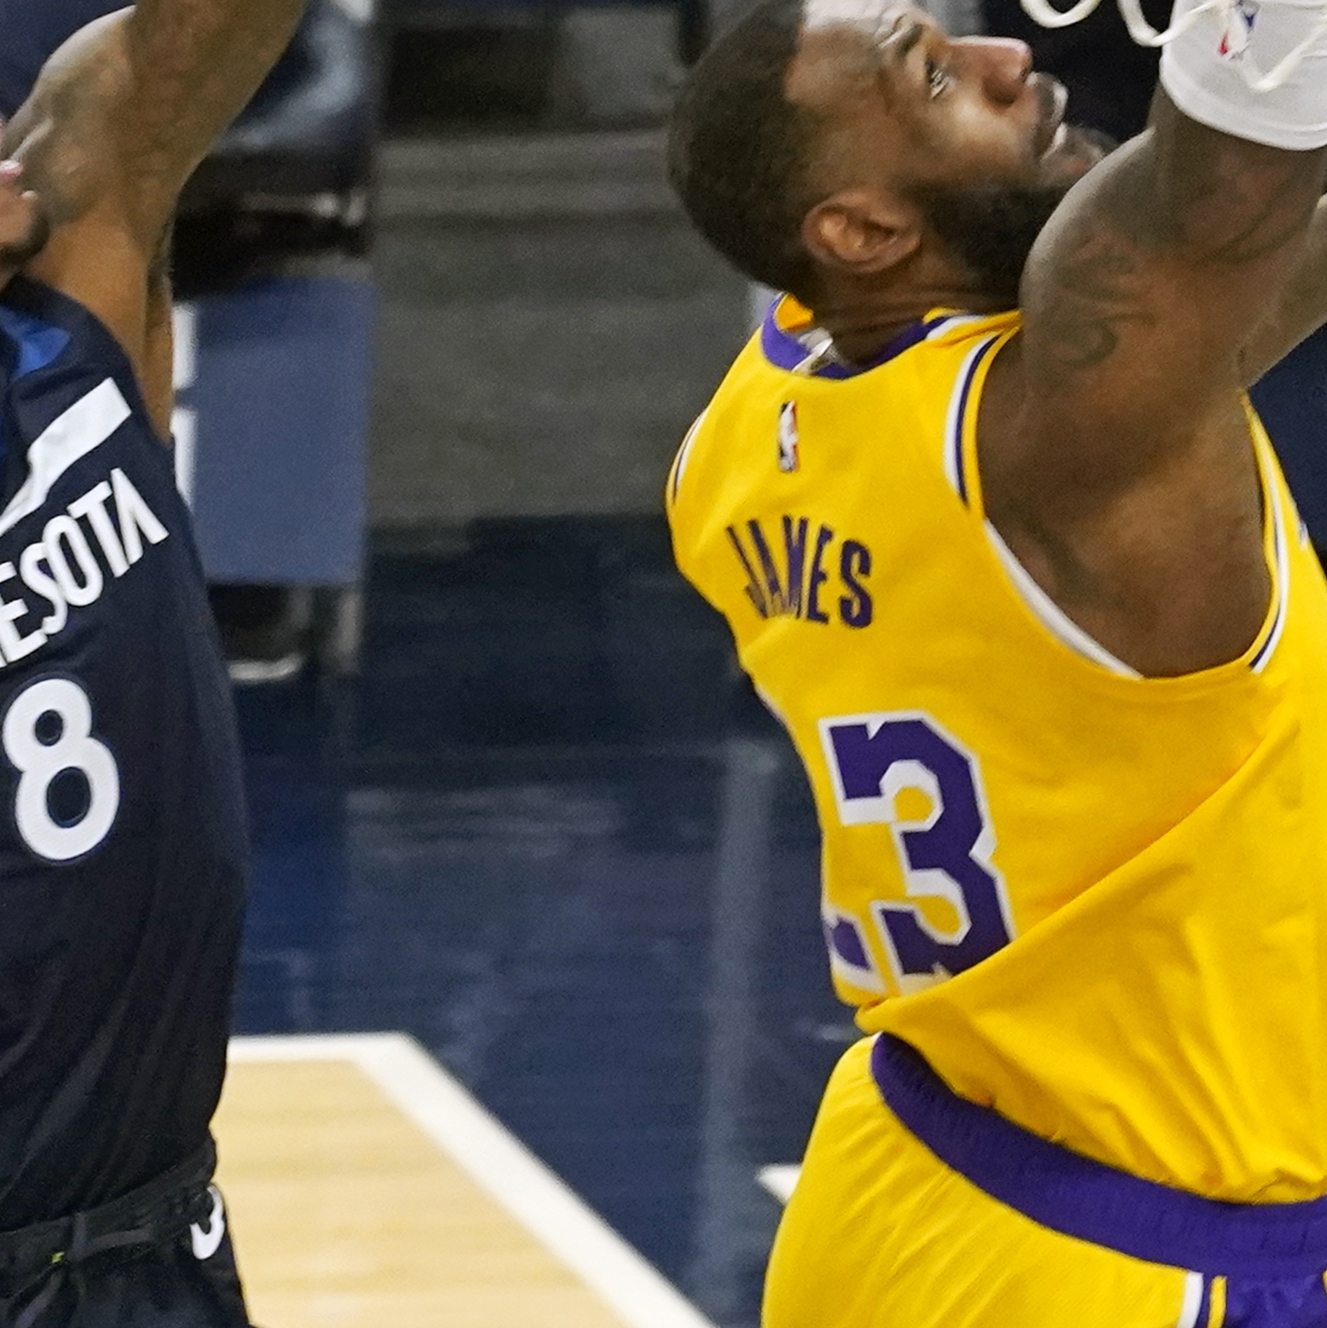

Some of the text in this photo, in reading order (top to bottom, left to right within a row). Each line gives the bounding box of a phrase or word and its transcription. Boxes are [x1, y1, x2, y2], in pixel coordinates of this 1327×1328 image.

[725, 514, 874, 629] JAMES
[2, 677, 120, 861] 8
[819, 709, 1019, 996] 3
